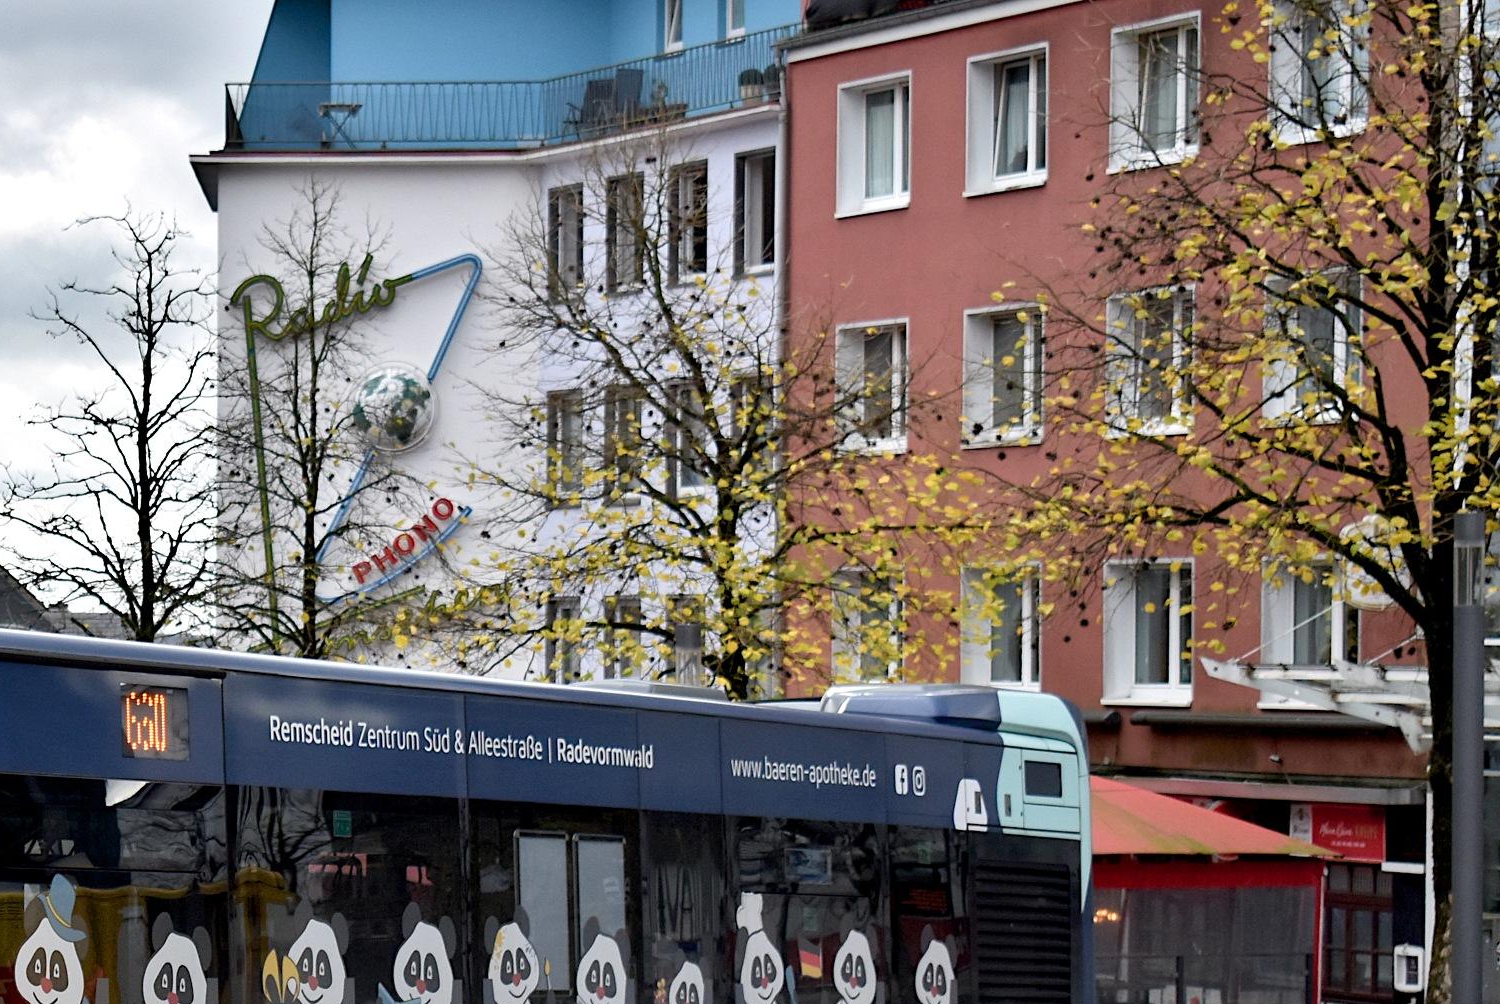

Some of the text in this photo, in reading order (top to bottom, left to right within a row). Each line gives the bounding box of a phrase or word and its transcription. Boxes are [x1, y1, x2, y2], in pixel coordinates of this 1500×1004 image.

[231, 252, 413, 341] Radio
[351, 498, 454, 584] PHONO
[269, 715, 353, 747] Remscheid
[358, 722, 420, 751] Zentrum
[424, 727, 450, 754] Süd
[454, 729, 465, 755] &
[468, 734, 543, 761] Alleestraße
[557, 738, 653, 769] Radevormwald
[730, 756, 877, 789] www.baeren-apotheke.de
